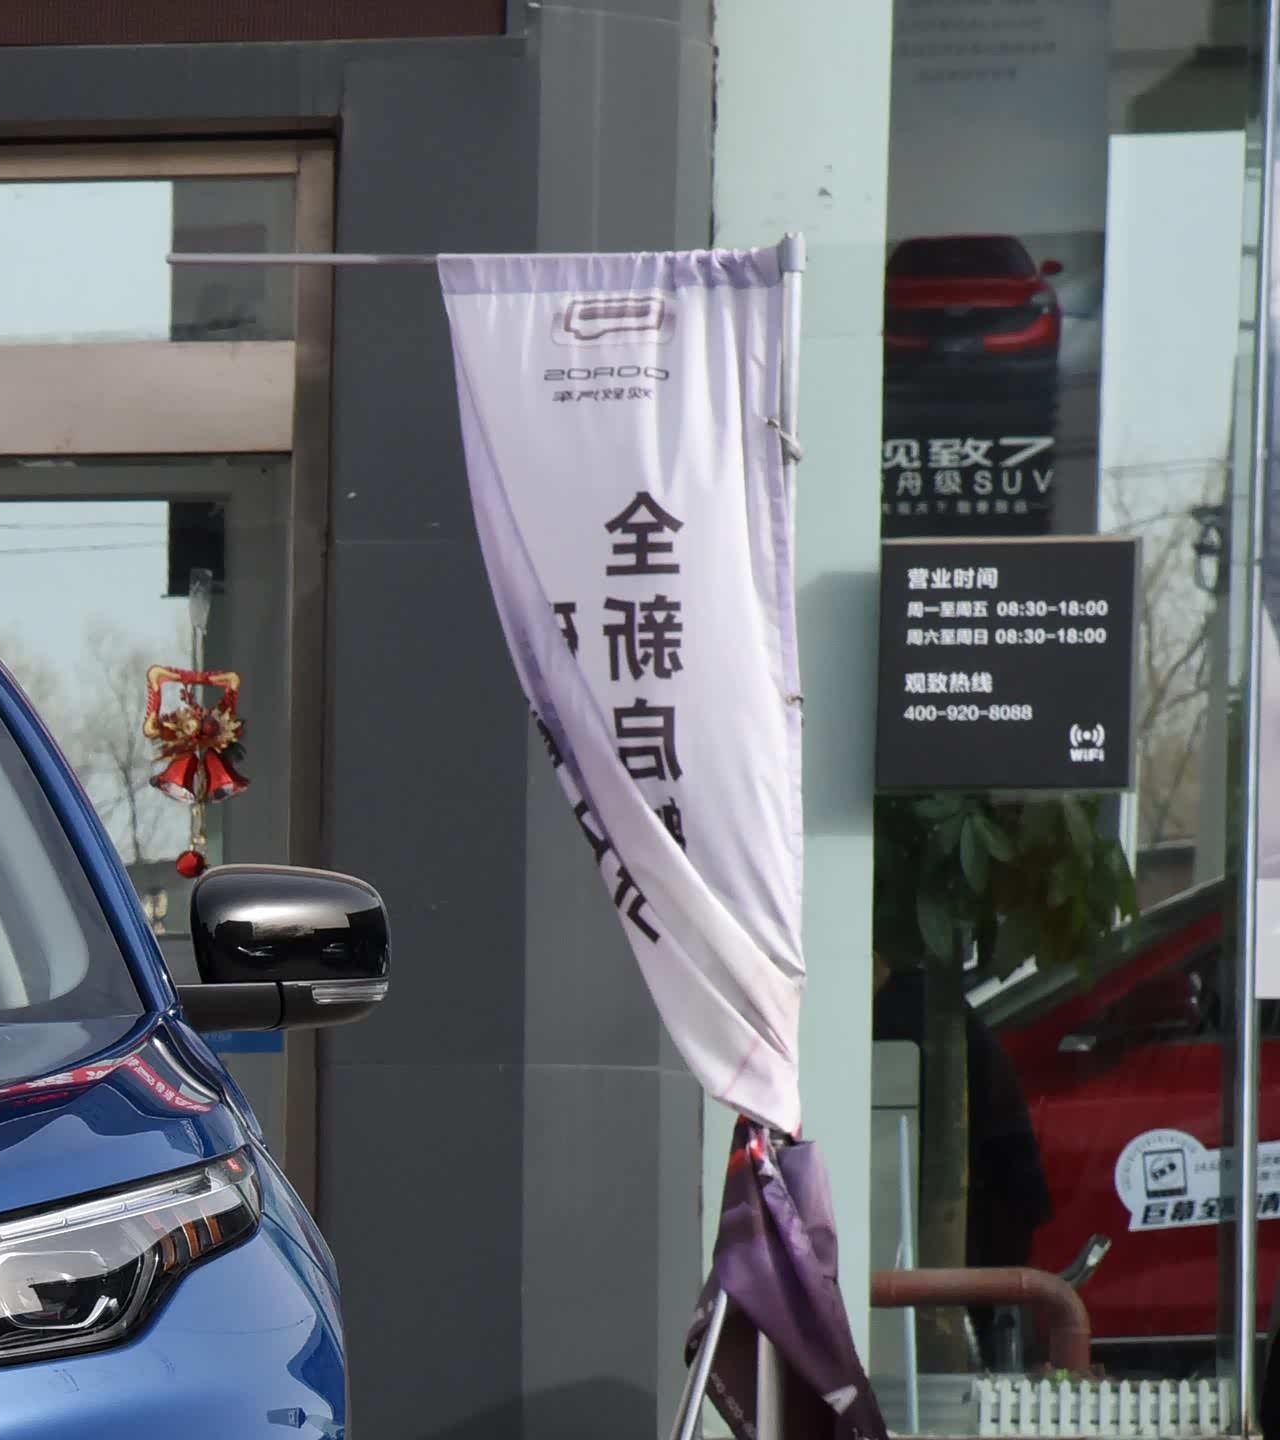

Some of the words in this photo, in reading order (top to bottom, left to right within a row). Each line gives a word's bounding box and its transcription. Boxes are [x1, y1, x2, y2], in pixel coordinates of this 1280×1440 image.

[907, 567, 999, 590] 营业时间
[907, 601, 989, 619] 周一至周五
[996, 600, 1109, 617] 08:30-18:00
[906, 628, 989, 646] 周六至周日
[994, 627, 1107, 645] 08:30-18:00
[904, 671, 993, 694] 观致热线
[903, 704, 1033, 721] 400-920-8088
